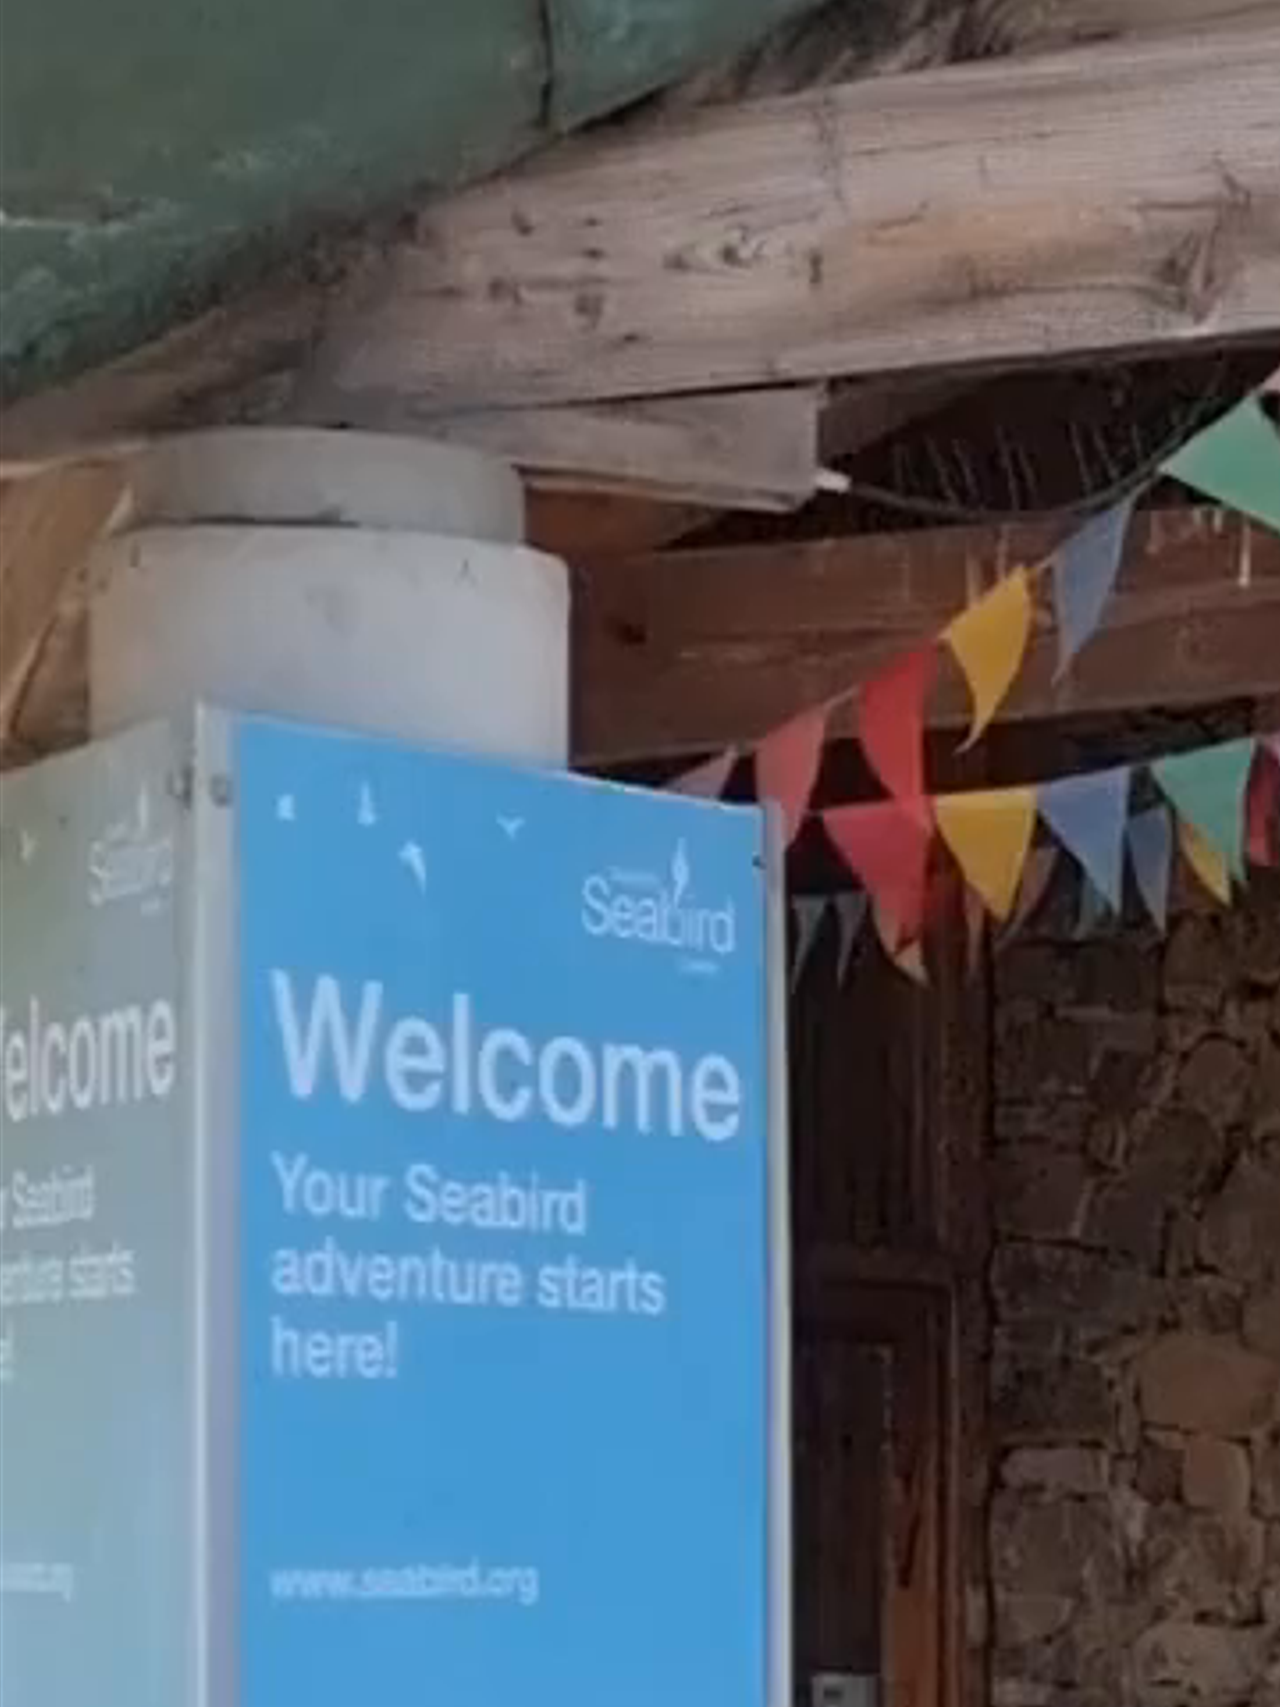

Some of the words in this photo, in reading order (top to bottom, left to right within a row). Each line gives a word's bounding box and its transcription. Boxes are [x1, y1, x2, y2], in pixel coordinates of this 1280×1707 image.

[581, 873, 736, 956] Seabird
[0, 995, 175, 1123] elcome
[271, 968, 741, 1143] Welcome
[271, 1151, 388, 1223] Your
[404, 1163, 586, 1236] Seabird
[272, 1239, 522, 1308] adventure
[537, 1256, 666, 1315] starts
[272, 1317, 398, 1381] here!
